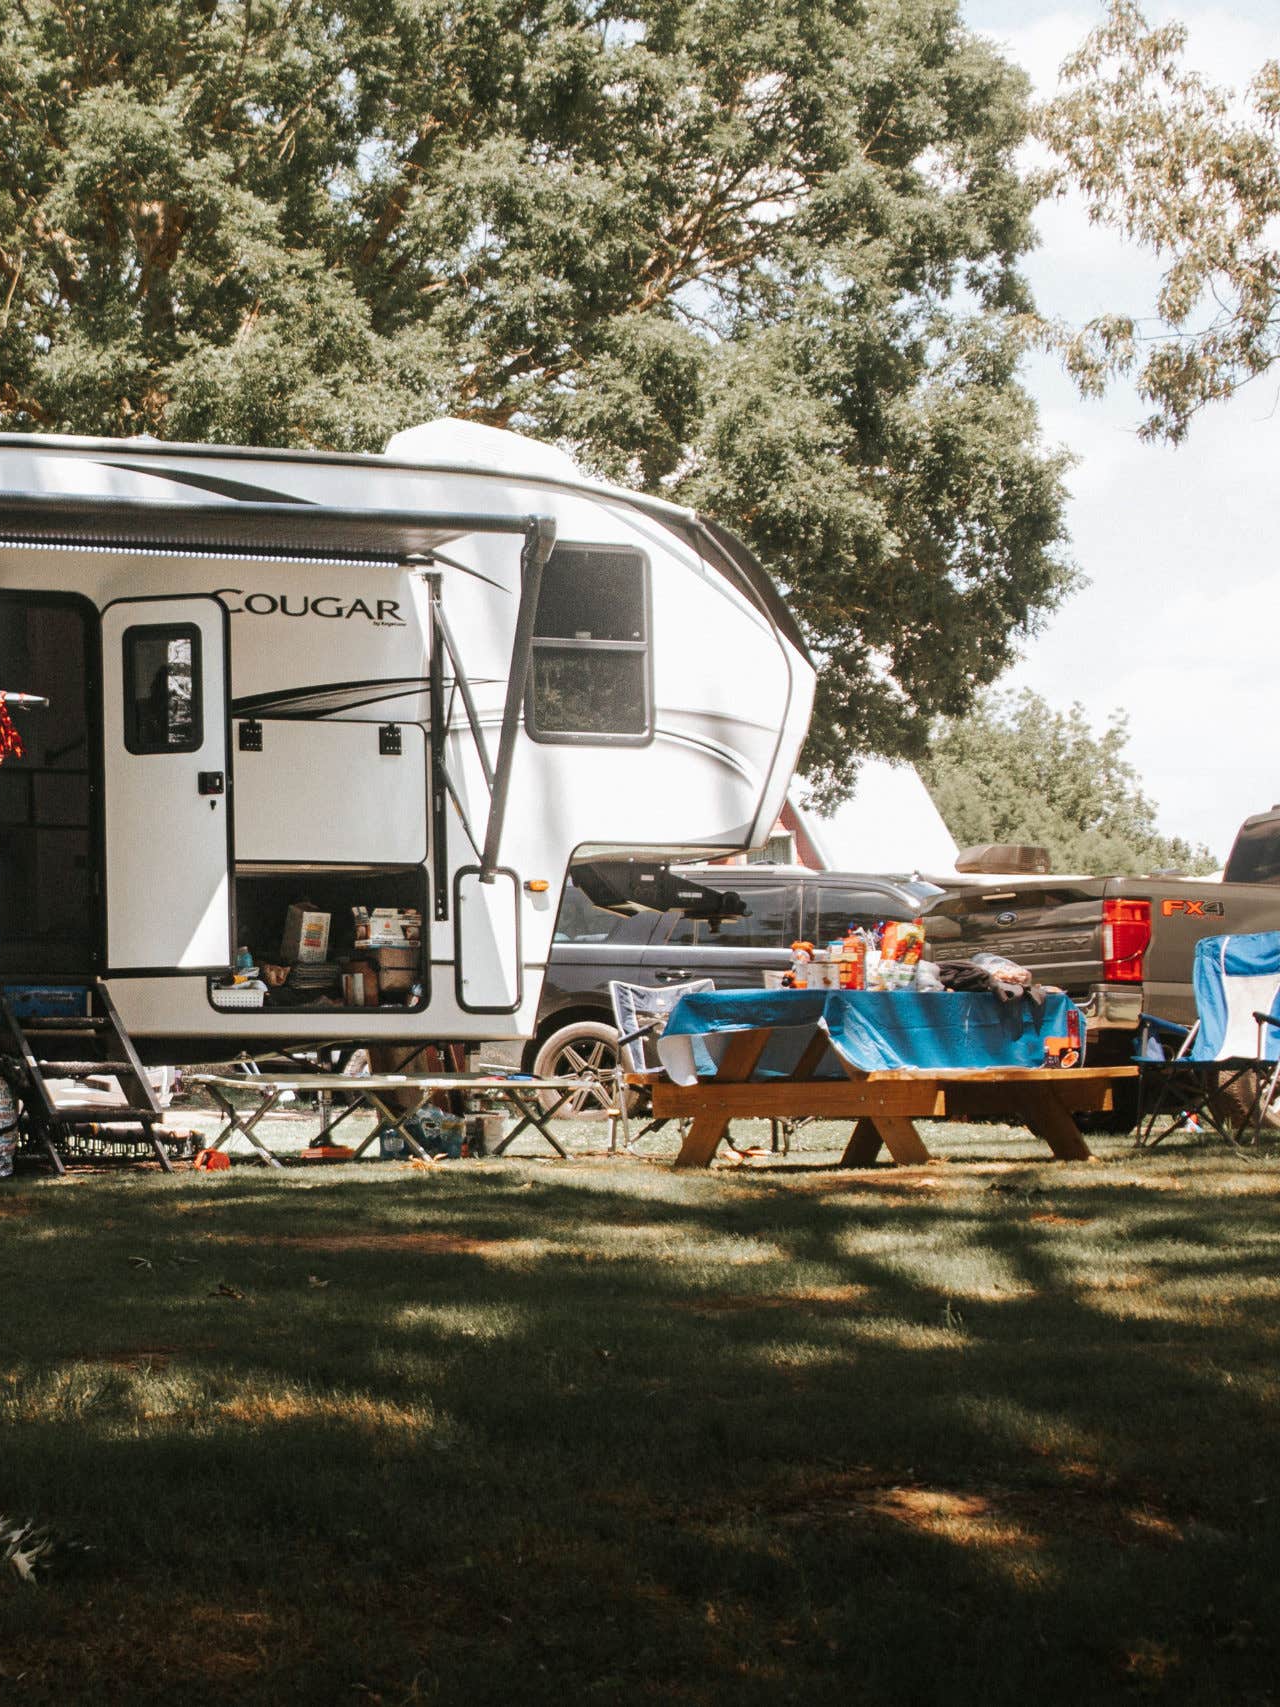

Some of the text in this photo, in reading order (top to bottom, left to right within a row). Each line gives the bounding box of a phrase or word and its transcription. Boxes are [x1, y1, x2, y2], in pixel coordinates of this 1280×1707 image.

[213, 588, 404, 621] COUGAR
[1161, 898, 1224, 917] FX4
[935, 936, 1091, 960] SUPER DUTY
